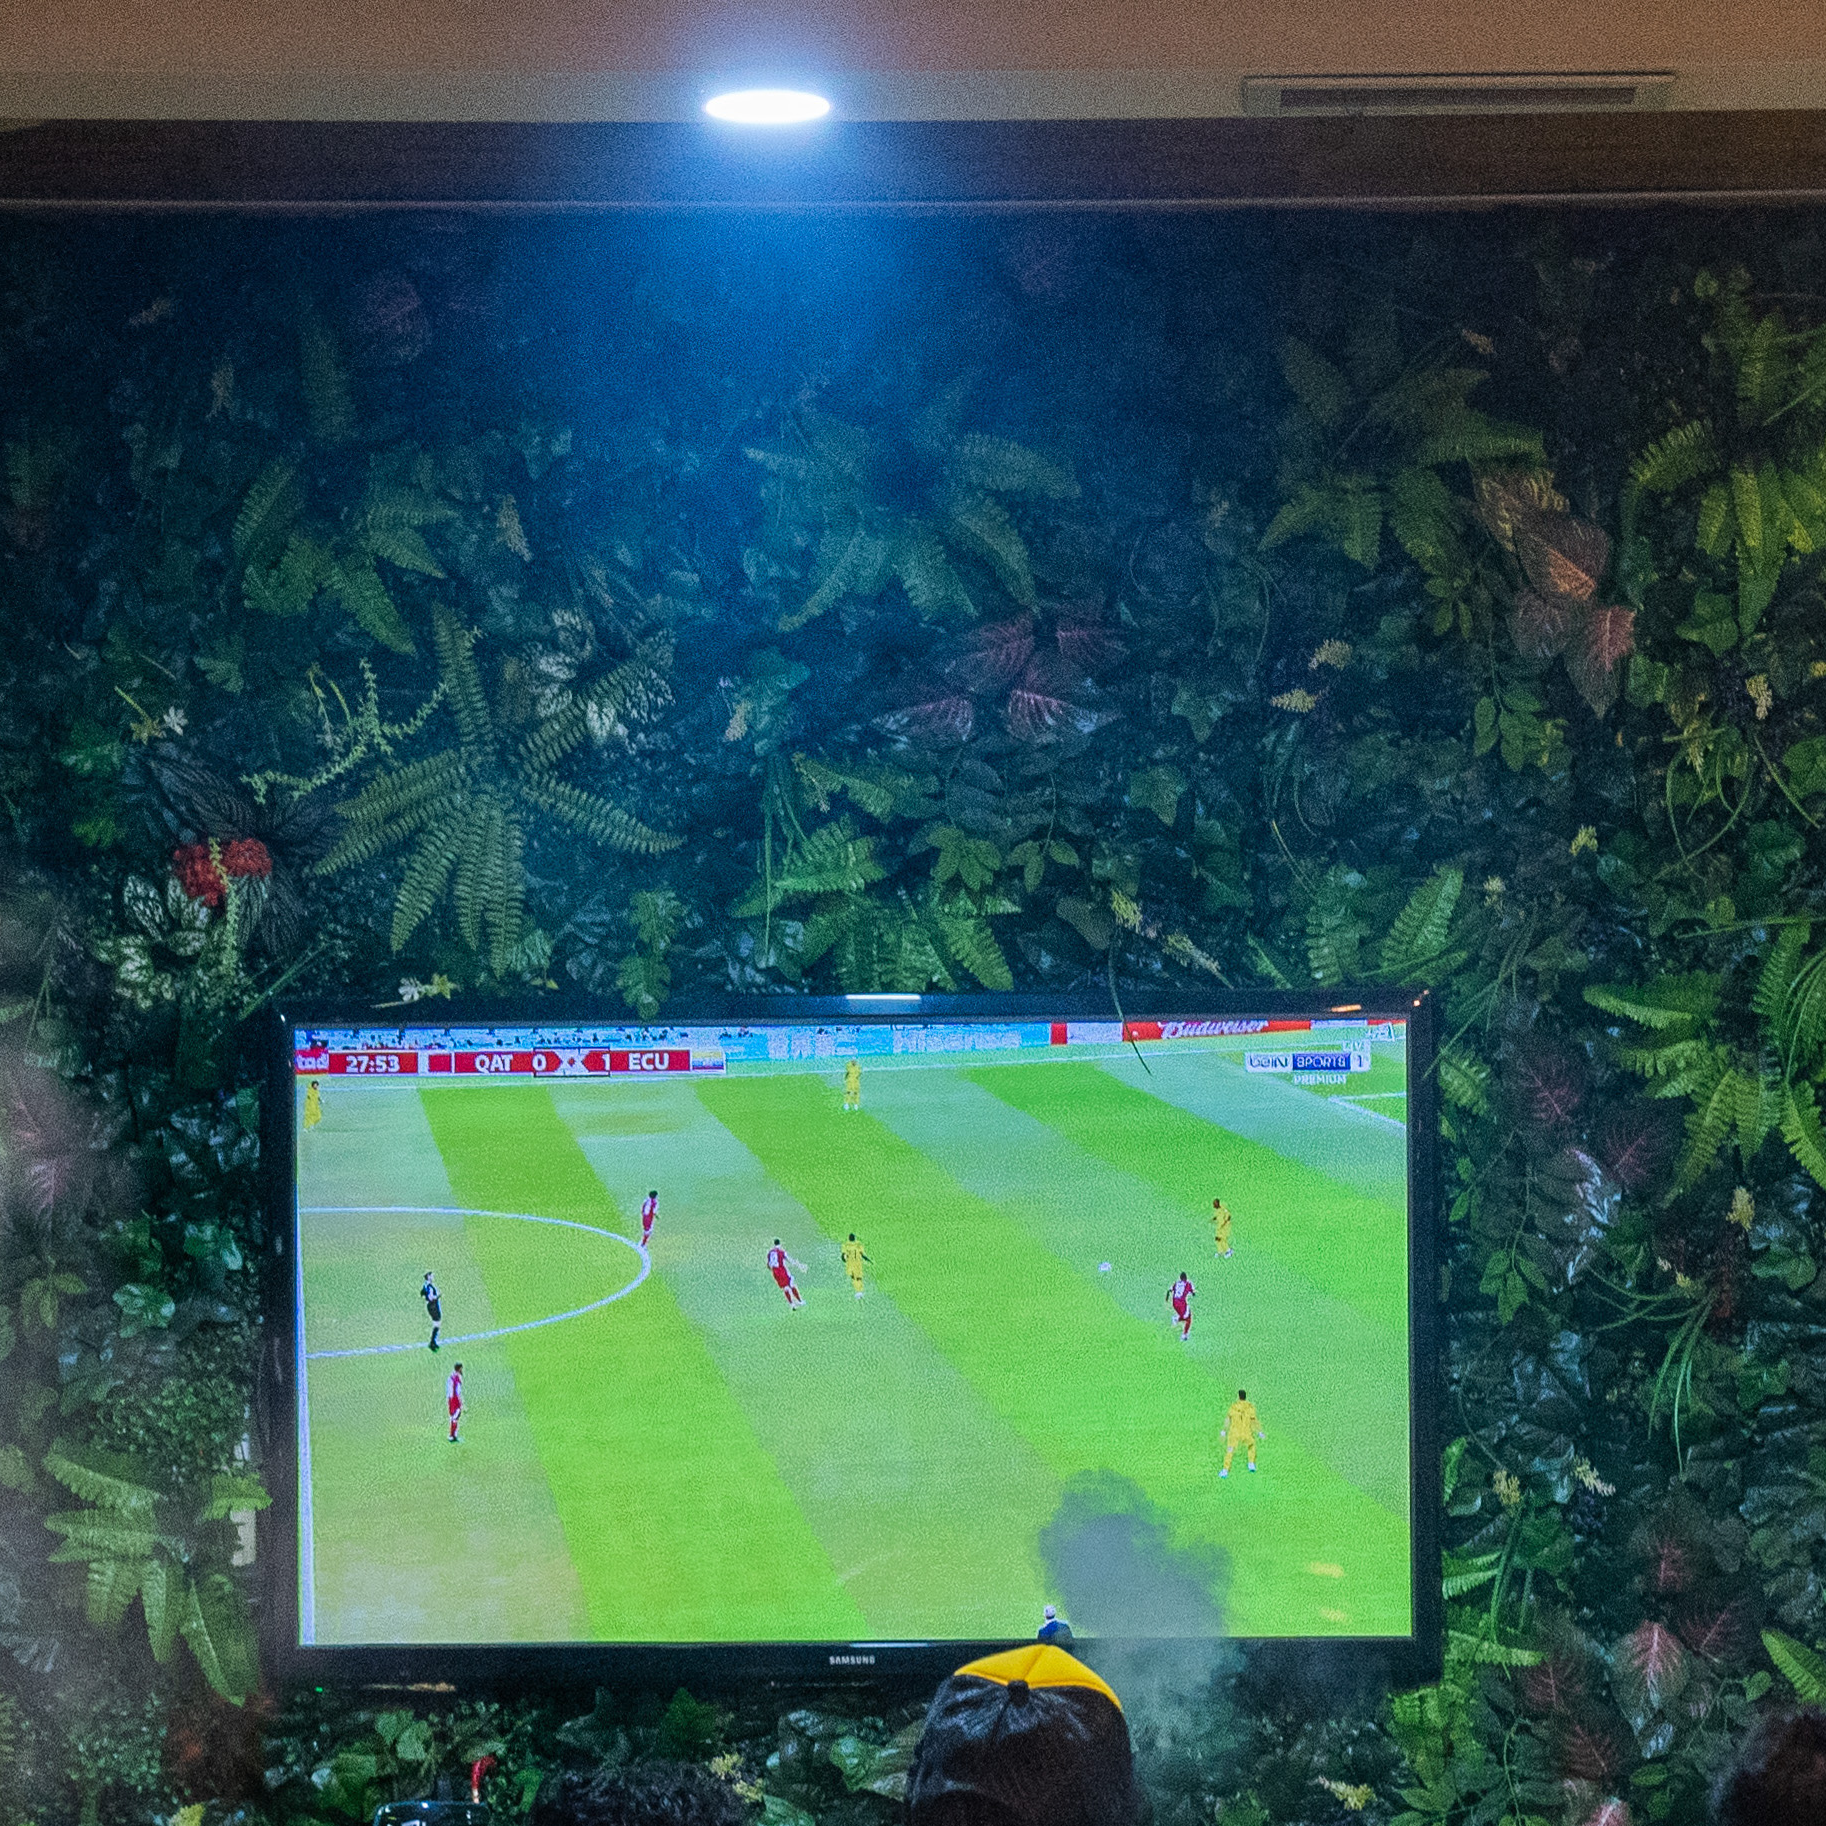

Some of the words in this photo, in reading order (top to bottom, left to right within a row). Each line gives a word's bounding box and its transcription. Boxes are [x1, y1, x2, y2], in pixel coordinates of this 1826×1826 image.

[345, 1054, 400, 1072] 27:53
[474, 1053, 513, 1073] QAT
[531, 1053, 547, 1071] 0
[601, 1053, 610, 1071] 1
[628, 1053, 669, 1071] ECU
[1293, 1074, 1347, 1085] PREMIUM
[829, 1655, 876, 1665] SAMSUNG
